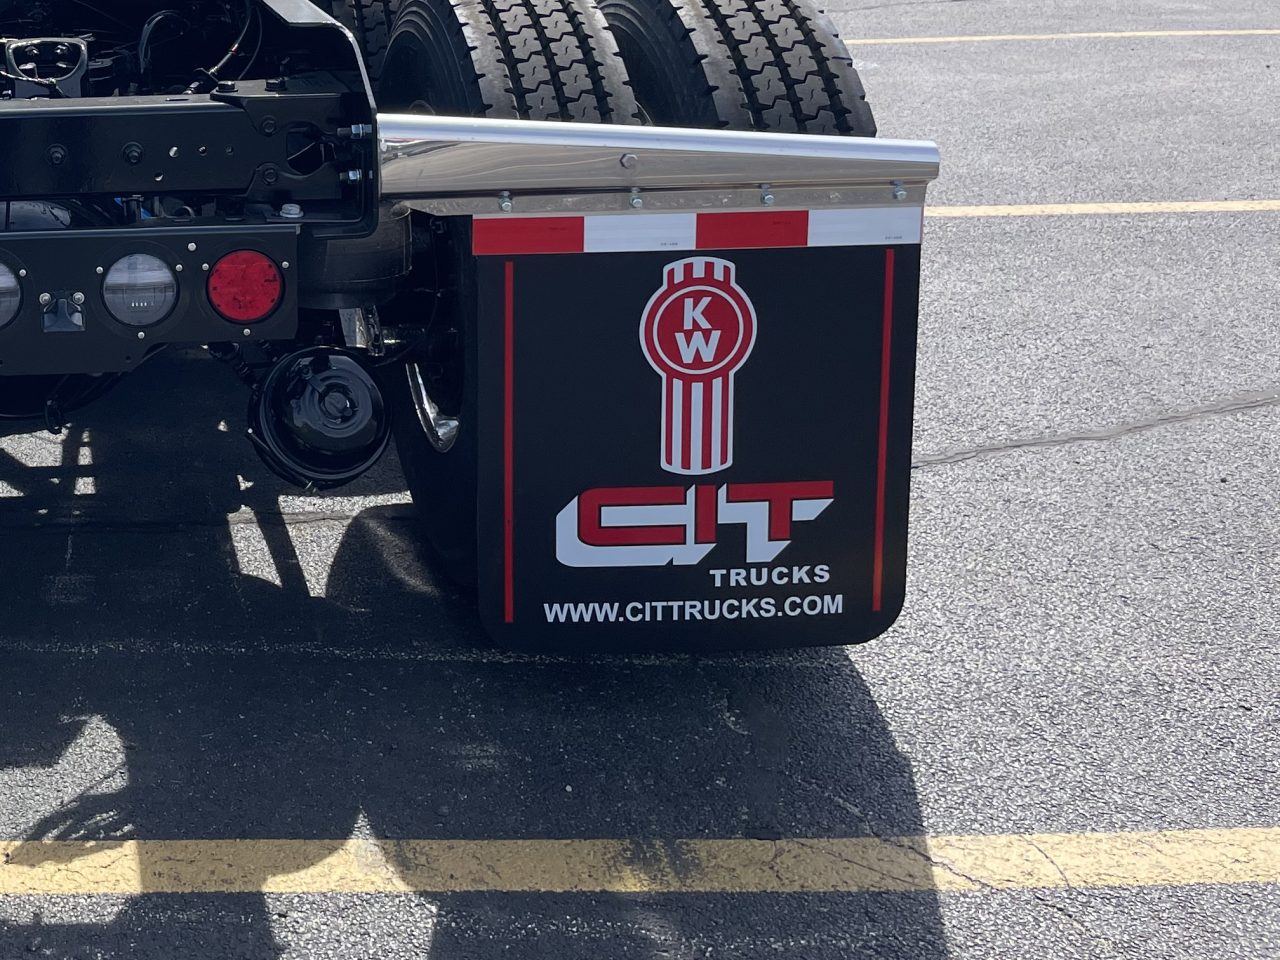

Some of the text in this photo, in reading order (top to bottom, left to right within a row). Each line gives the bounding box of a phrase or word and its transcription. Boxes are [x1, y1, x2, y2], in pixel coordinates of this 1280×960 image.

[555, 480, 835, 568] CIT
[709, 564, 830, 587] TRUCKS
[543, 594, 844, 623] WWW.CITTRUCKS.COM
